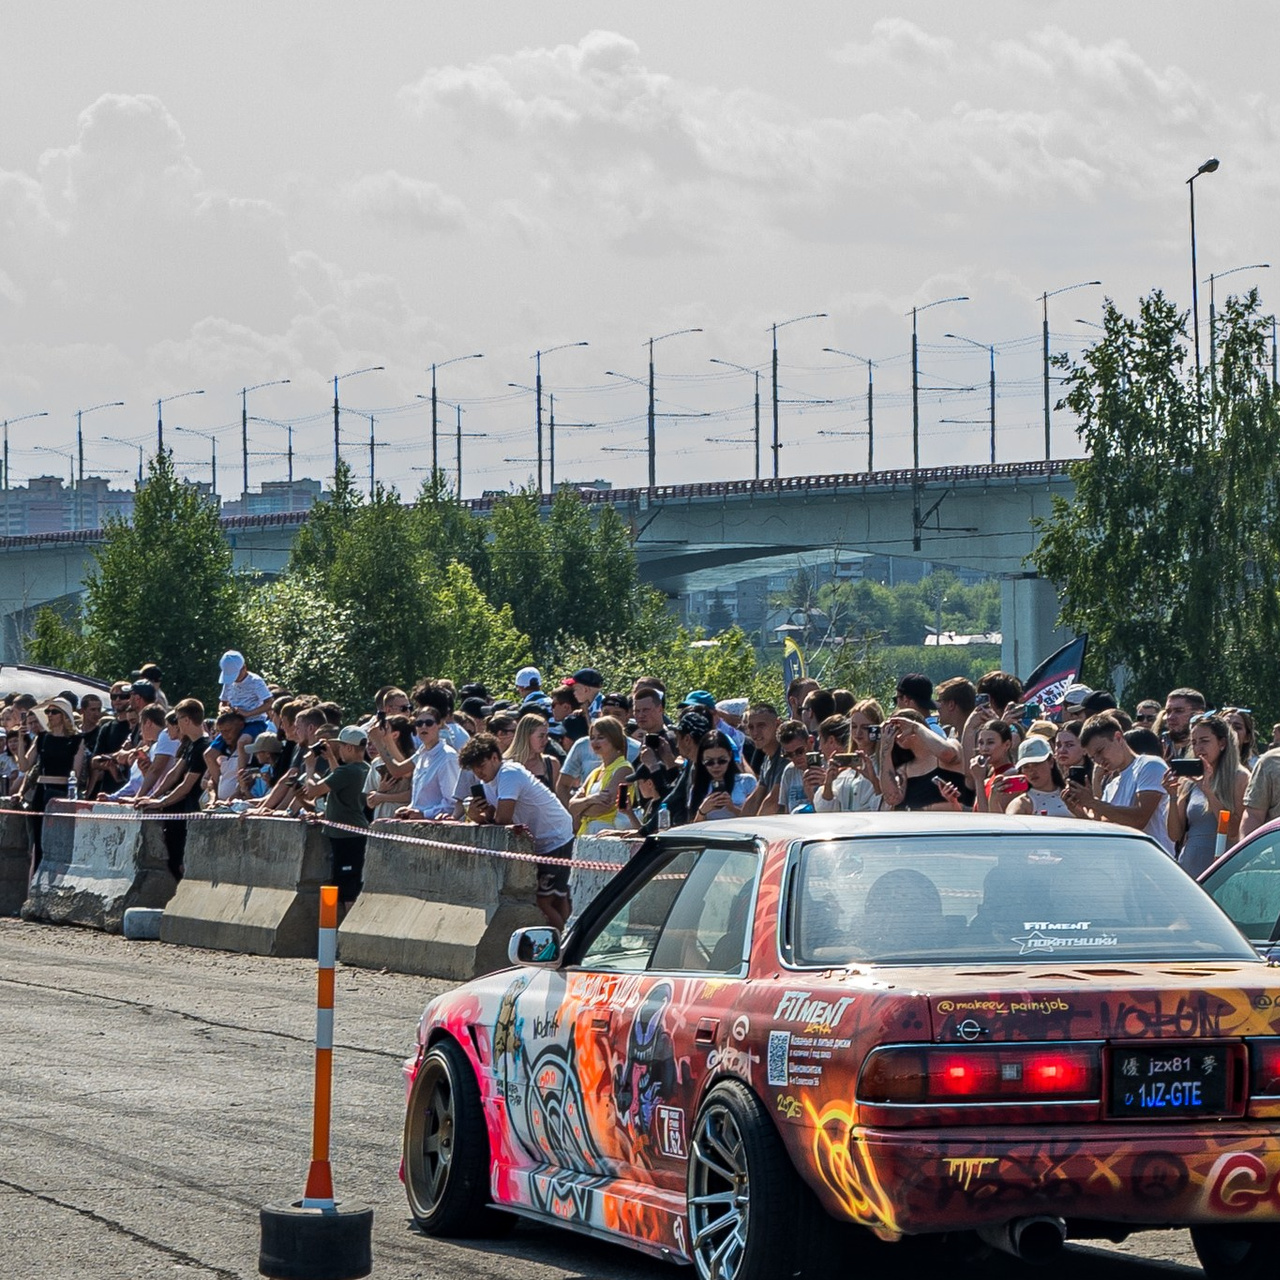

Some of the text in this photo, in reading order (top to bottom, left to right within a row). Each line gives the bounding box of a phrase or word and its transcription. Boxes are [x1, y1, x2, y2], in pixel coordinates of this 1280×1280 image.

[1027, 936, 1117, 948] ПОКАТУШКИ
[937, 997, 1069, 1015] @makeev_paintjob
[1147, 1057, 1191, 1076] jzx81
[1138, 1081, 1202, 1107] 1JZ-GTE
